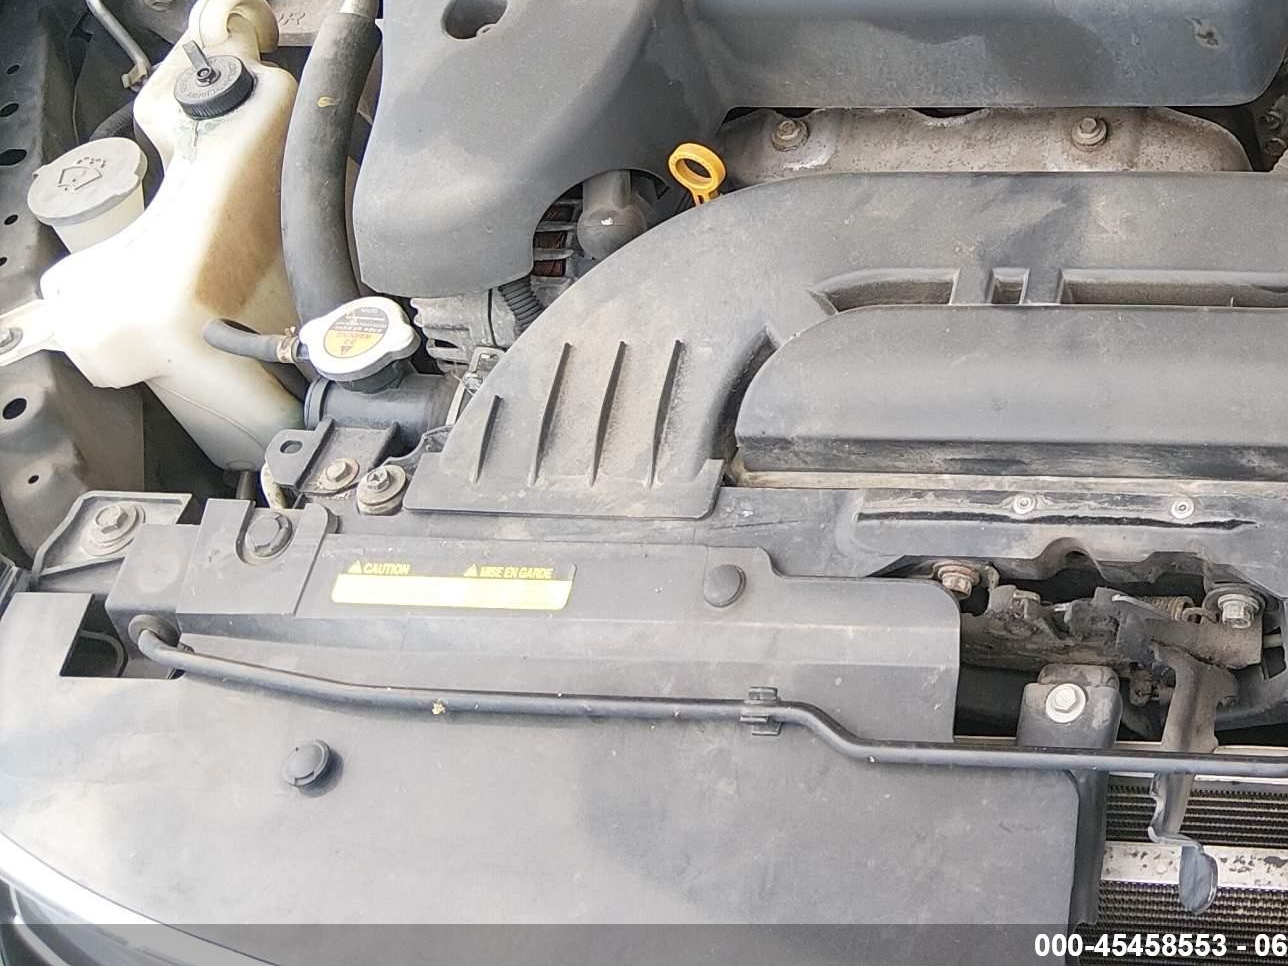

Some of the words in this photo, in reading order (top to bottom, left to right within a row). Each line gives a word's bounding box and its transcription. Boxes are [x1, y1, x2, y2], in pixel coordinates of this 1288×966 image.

[363, 563, 410, 575] CAUTION
[479, 566, 503, 578] MISE
[503, 567, 518, 578] EN
[518, 567, 553, 579] GARDE
